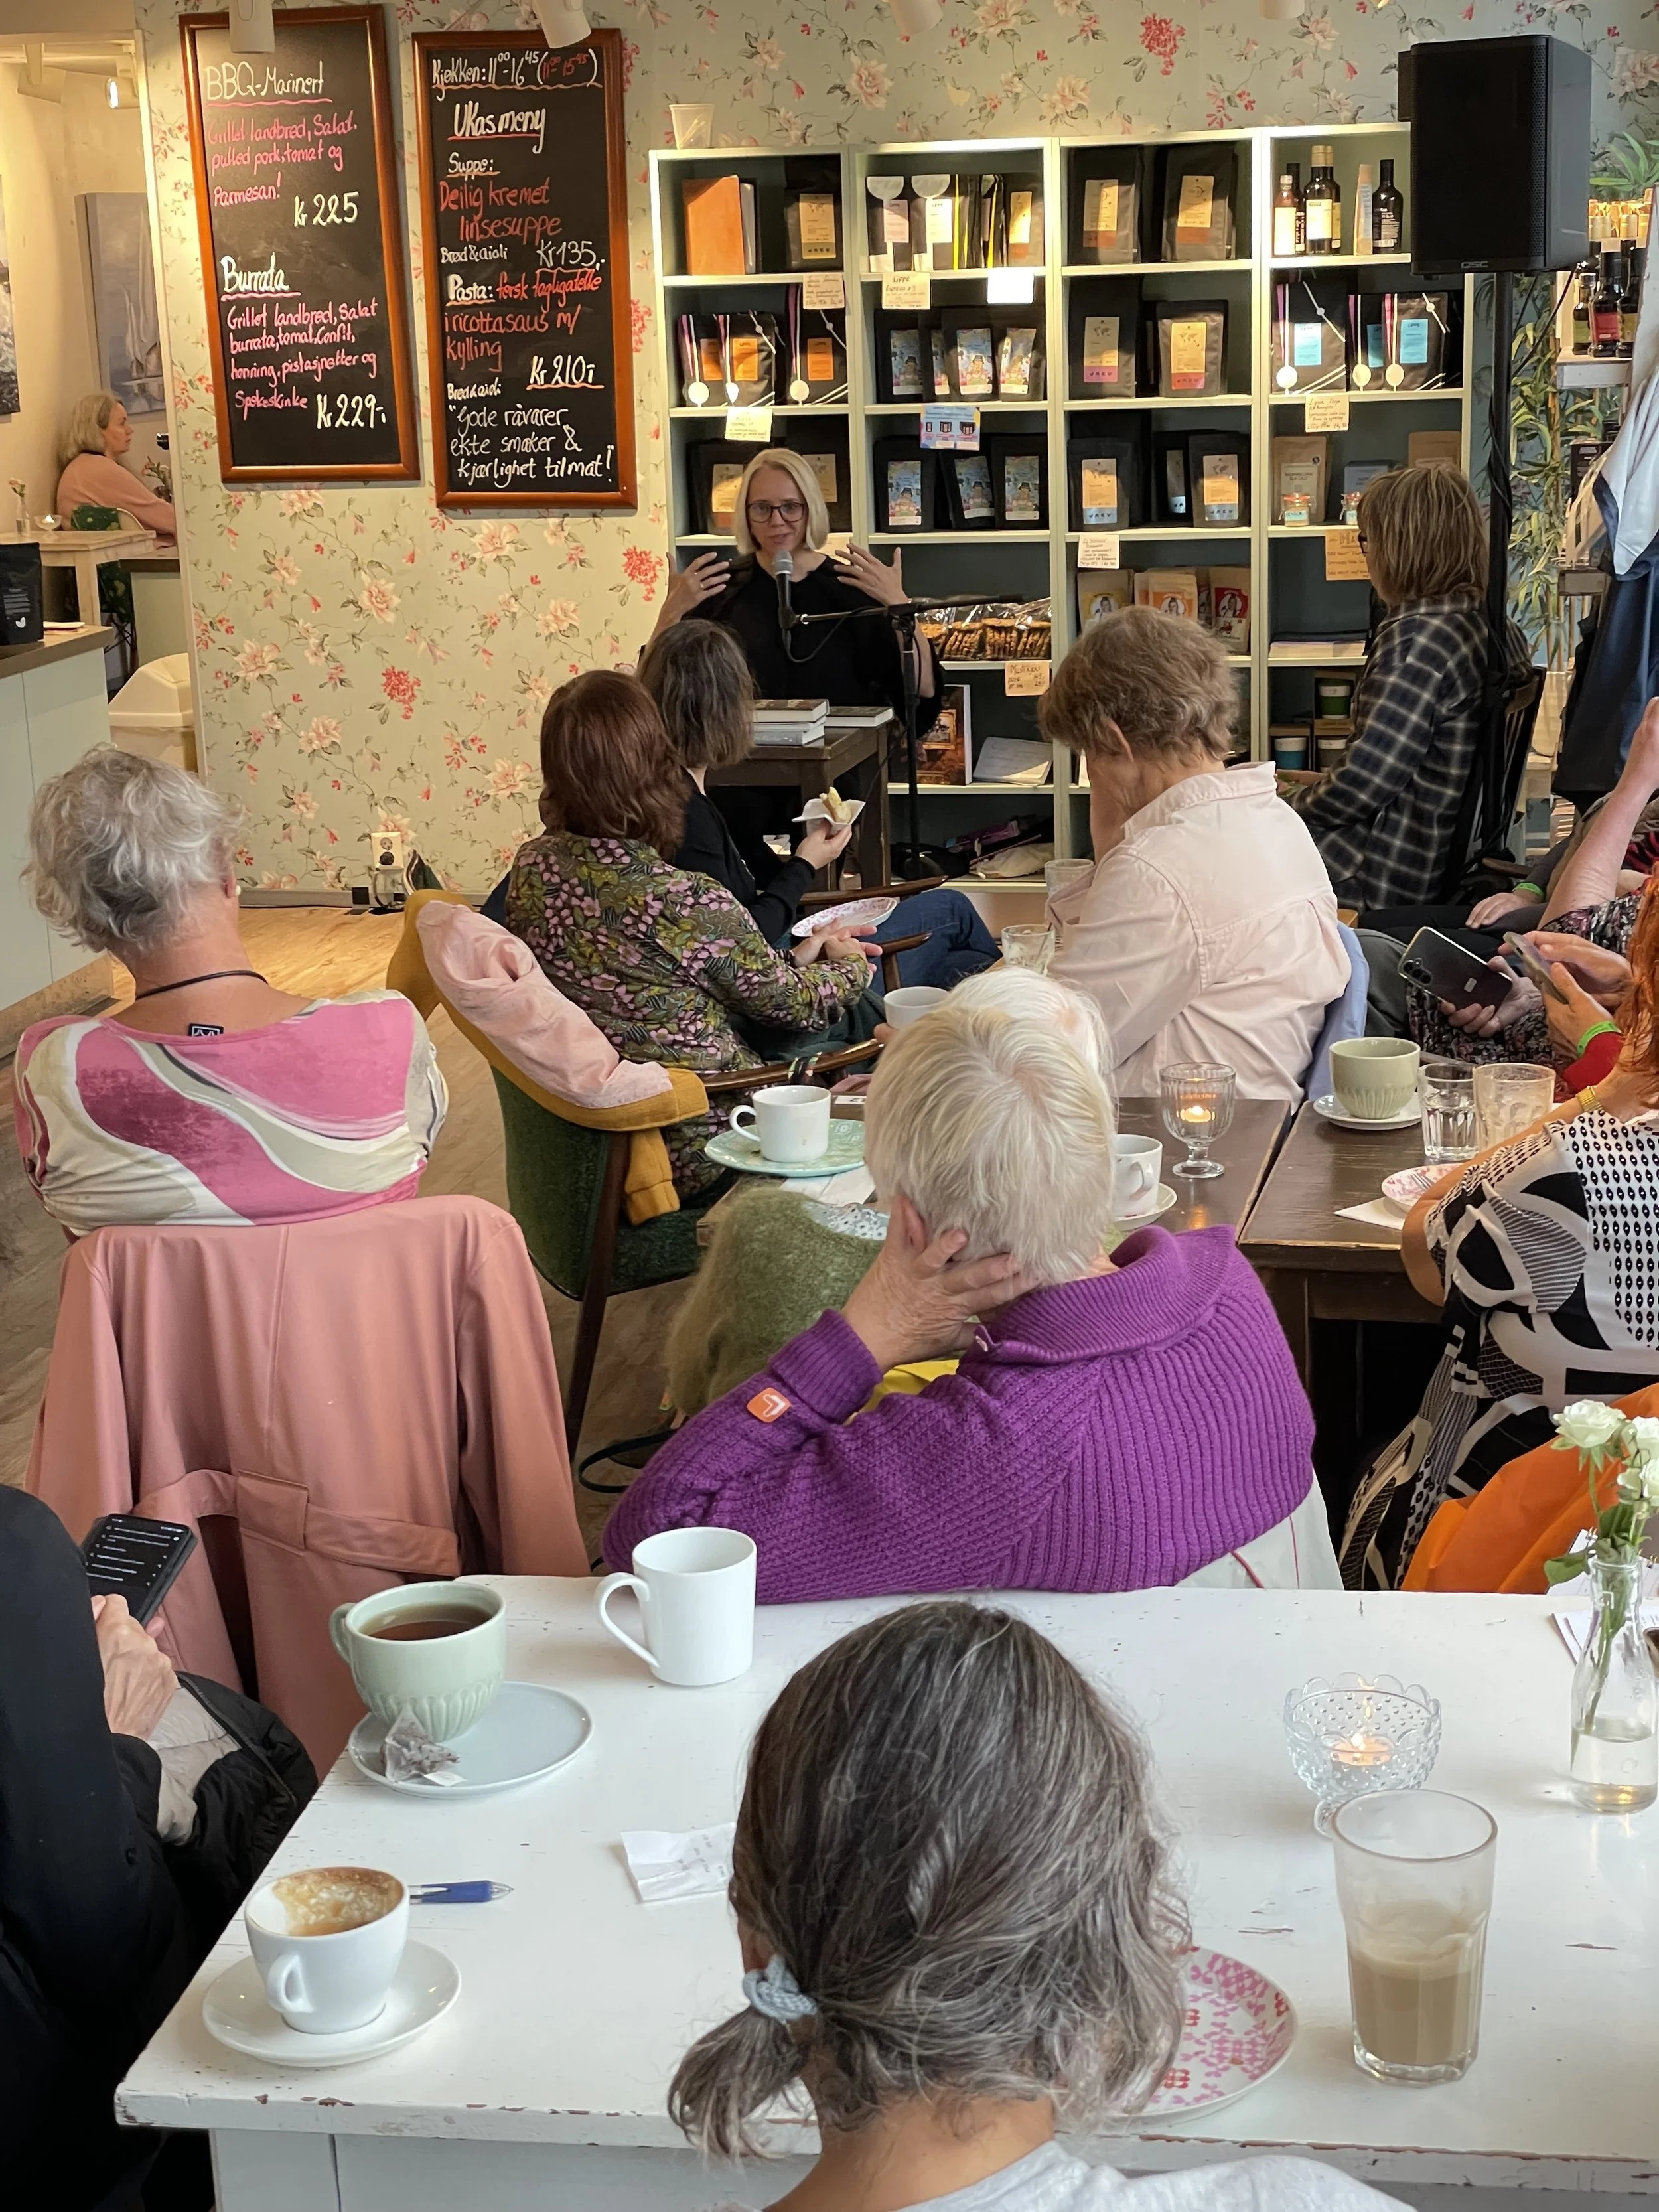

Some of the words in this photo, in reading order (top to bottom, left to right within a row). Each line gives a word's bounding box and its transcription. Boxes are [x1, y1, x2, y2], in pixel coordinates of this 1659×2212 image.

[206, 60, 324, 100] BBQ-Marinert
[498, 108, 546, 154] meny
[212, 146, 250, 177] pulled
[328, 145, 343, 172] og
[448, 151, 493, 181] Suppe:
[214, 171, 282, 207] Parmesan!
[439, 180, 483, 220] Deilig
[488, 177, 550, 207] kremet
[313, 191, 360, 226] 225
[459, 214, 562, 246] linsesuppe
[221, 252, 289, 293] Burrata
[447, 273, 494, 301] Pasta:
[496, 271, 529, 300] fersk
[227, 303, 267, 330] Grillet
[338, 297, 378, 321] Salat
[361, 352, 377, 379] og
[446, 336, 502, 372] kylling
[451, 434, 491, 457] ekte
[500, 431, 556, 453] smaker
[563, 423, 583, 452] &
[457, 458, 537, 488] kjærlighet
[544, 457, 567, 478] til
